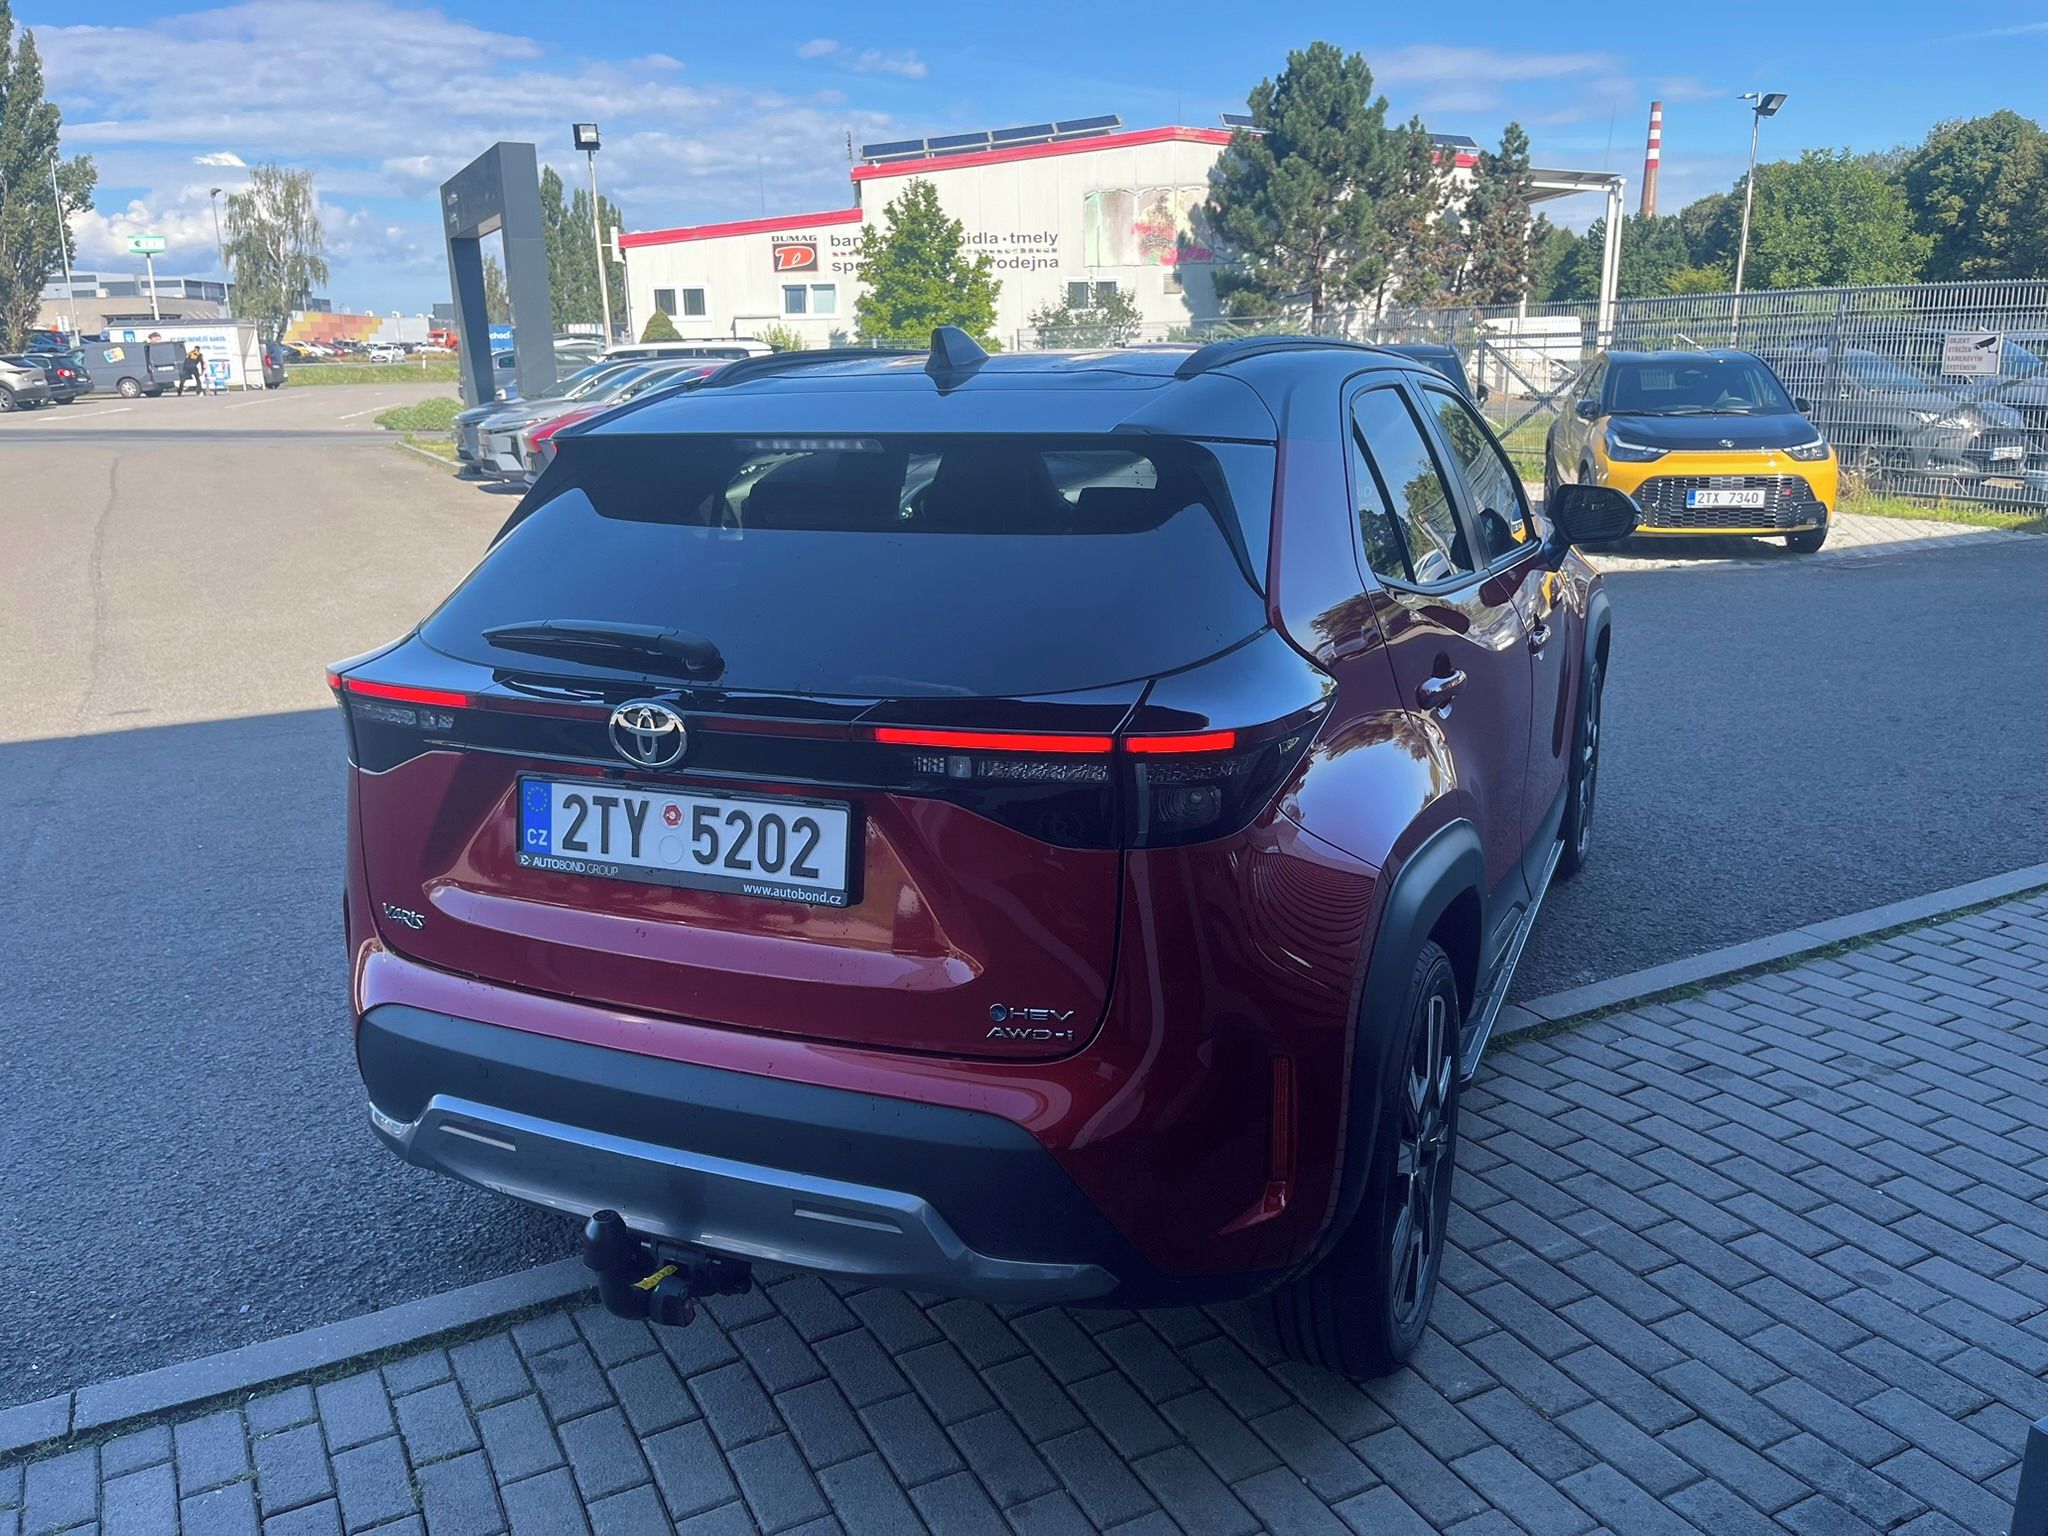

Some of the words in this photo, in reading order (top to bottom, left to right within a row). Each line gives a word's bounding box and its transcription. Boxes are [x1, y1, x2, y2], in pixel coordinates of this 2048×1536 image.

[771, 234, 818, 242] DUMAG
[1009, 231, 1059, 246] tmely
[1697, 492, 1719, 504] 2TX
[1729, 492, 1759, 504] 7340
[527, 828, 548, 846] CZ
[562, 793, 650, 858] 2TY
[692, 804, 820, 879] 5202
[586, 863, 619, 877] GROUP
[743, 883, 842, 905] www.autobond.cz
[1009, 1007, 1075, 1021] HEV
[986, 1026, 1074, 1041] AWD-i
